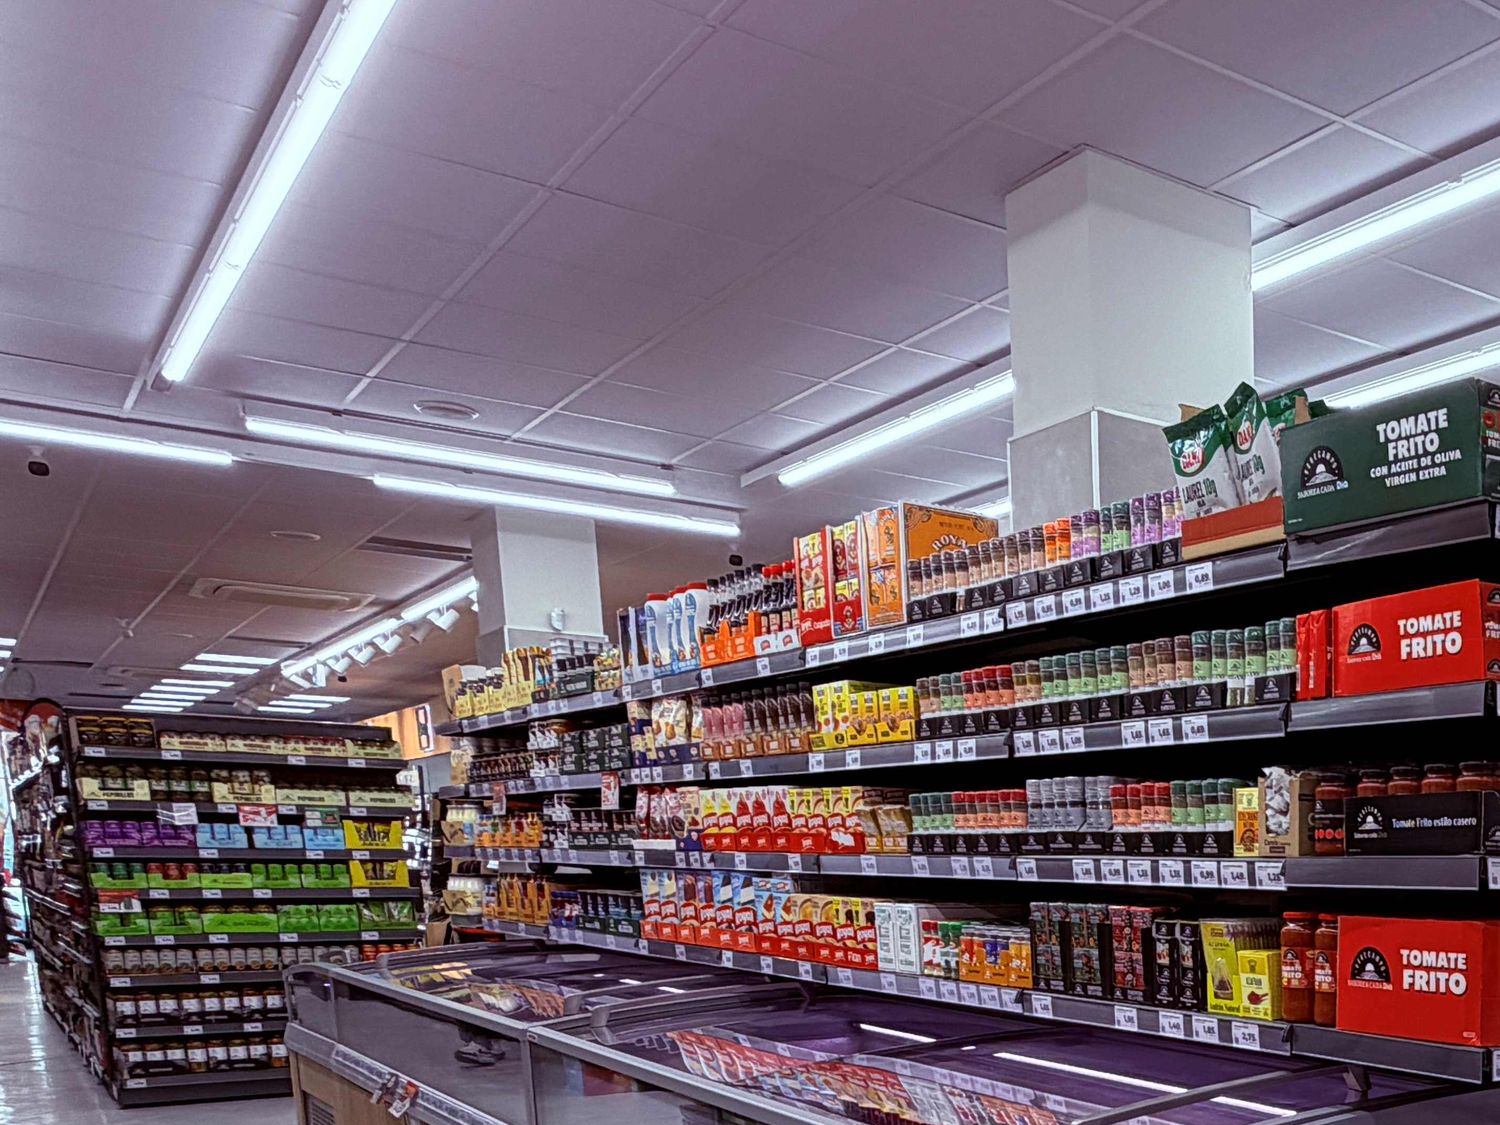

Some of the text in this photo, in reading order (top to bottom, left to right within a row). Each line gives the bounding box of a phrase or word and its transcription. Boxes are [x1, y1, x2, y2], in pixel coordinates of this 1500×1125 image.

[1376, 407, 1449, 443] TOMATE
[1387, 432, 1440, 462] FRITO
[1370, 449, 1462, 479] CON ACEITE DE OLIVA
[1385, 465, 1447, 487] VIRGEN EXTRA
[931, 534, 968, 551] ROYA
[1397, 610, 1463, 637] TOMATE
[1400, 631, 1464, 661] FRITO
[1391, 815, 1477, 829] Tomate Frito estilo casero
[1399, 948, 1468, 971] TOMATE
[1402, 968, 1469, 996] FRITO
